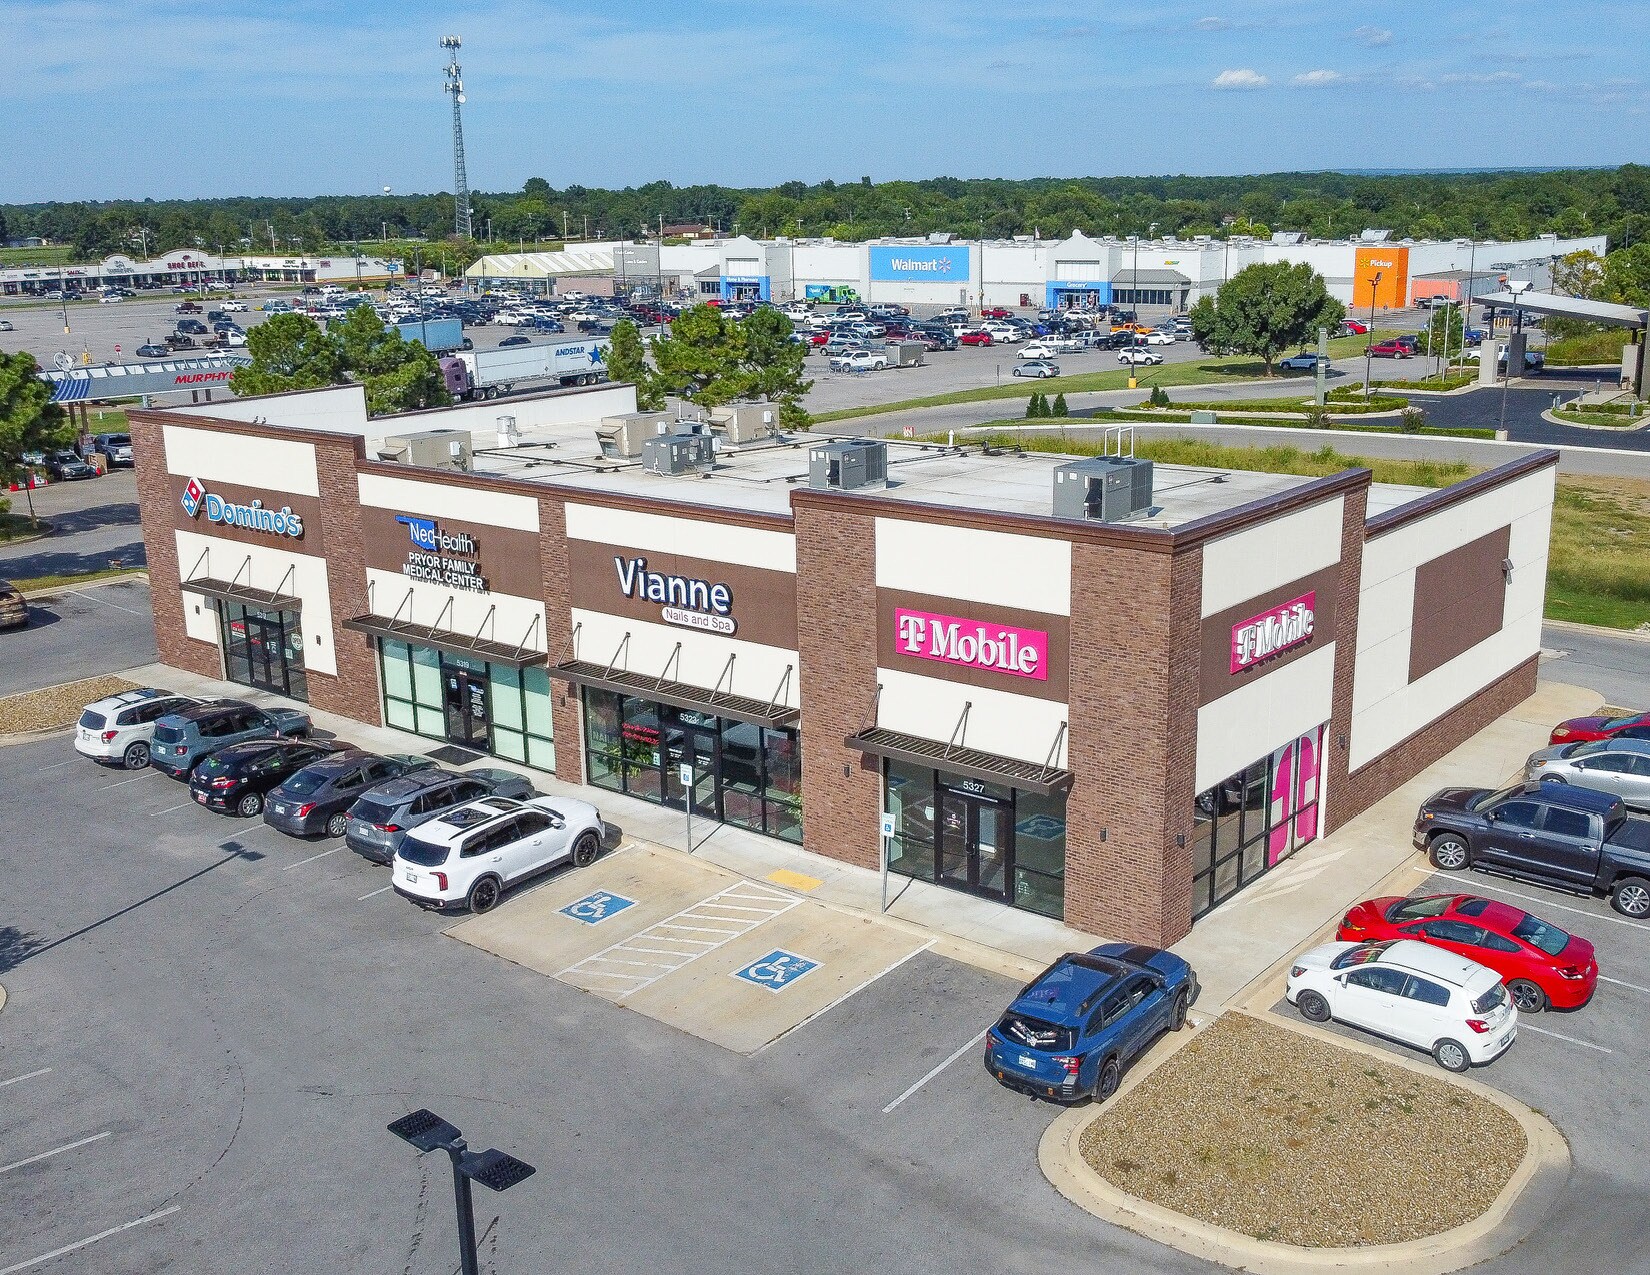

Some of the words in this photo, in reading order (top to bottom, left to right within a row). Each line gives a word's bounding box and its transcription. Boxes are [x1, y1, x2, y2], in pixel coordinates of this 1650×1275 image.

[891, 259, 937, 271] Walmart
[1370, 260, 1392, 268] Pickup
[206, 493, 304, 536] Domino's
[408, 552, 440, 568] PRYOR
[442, 558, 475, 574] FAMILY
[403, 563, 443, 582] MEDICAL
[445, 571, 484, 589] CENTER
[614, 556, 733, 615] Vianne
[666, 608, 690, 622] Nails
[691, 613, 709, 626] and
[711, 617, 731, 630] Spa
[963, 781, 985, 793] 5327
